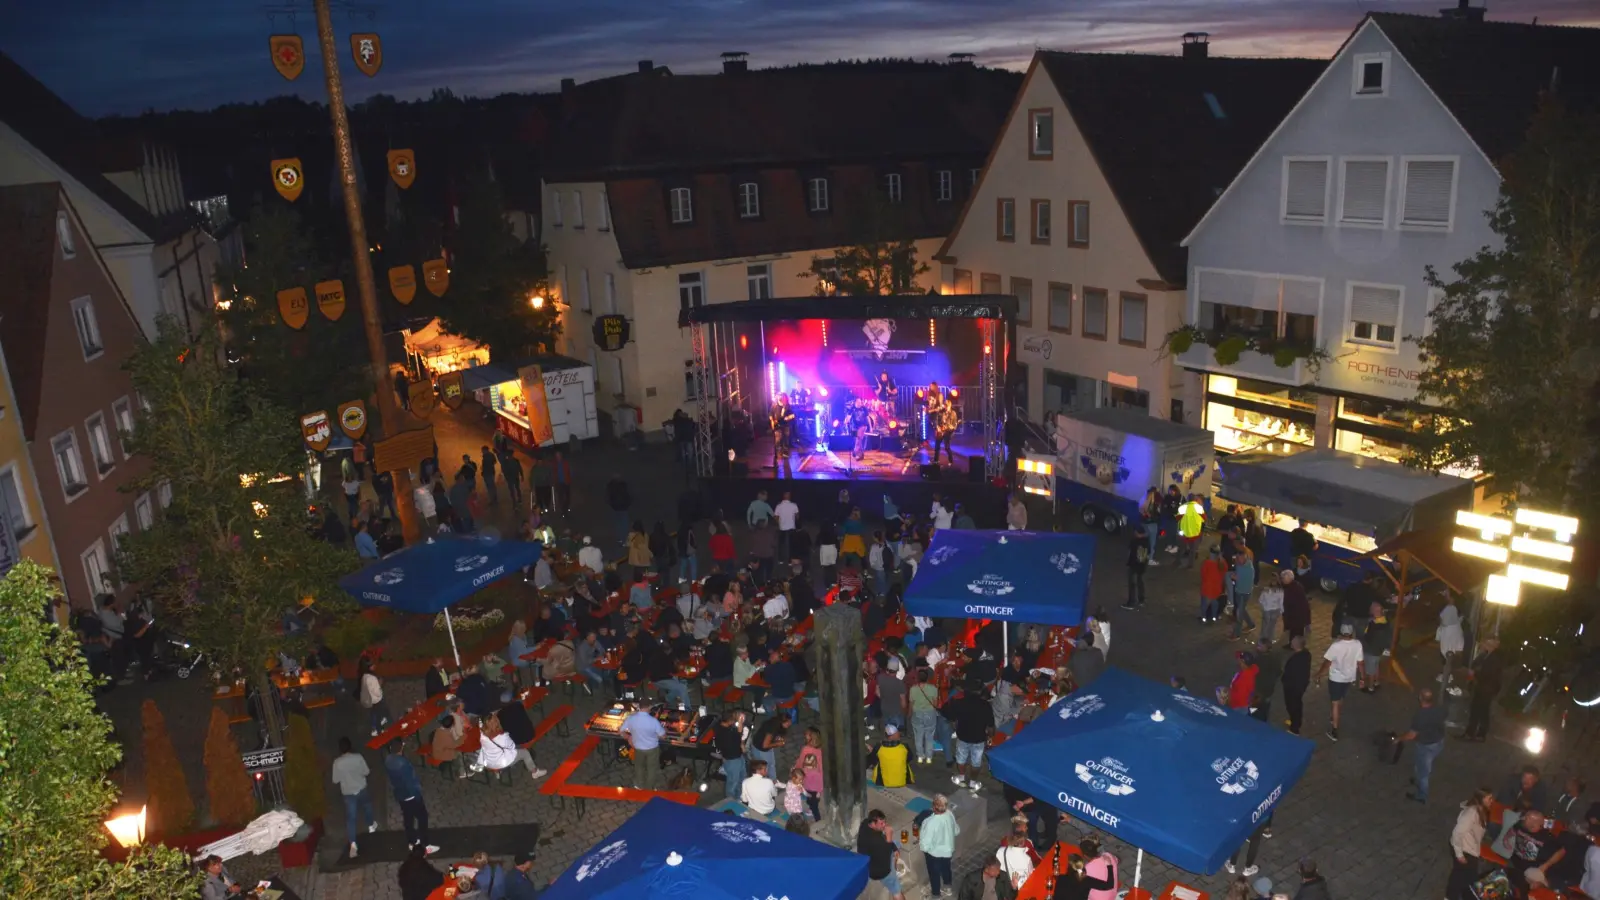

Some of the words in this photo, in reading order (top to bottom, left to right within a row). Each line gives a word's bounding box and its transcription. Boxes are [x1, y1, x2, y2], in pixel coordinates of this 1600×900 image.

[604, 318, 621, 327] Pils
[604, 326, 622, 336] Pub
[1347, 361, 1420, 381] ROTHENB
[244, 756, 284, 767] SCHMIDT
